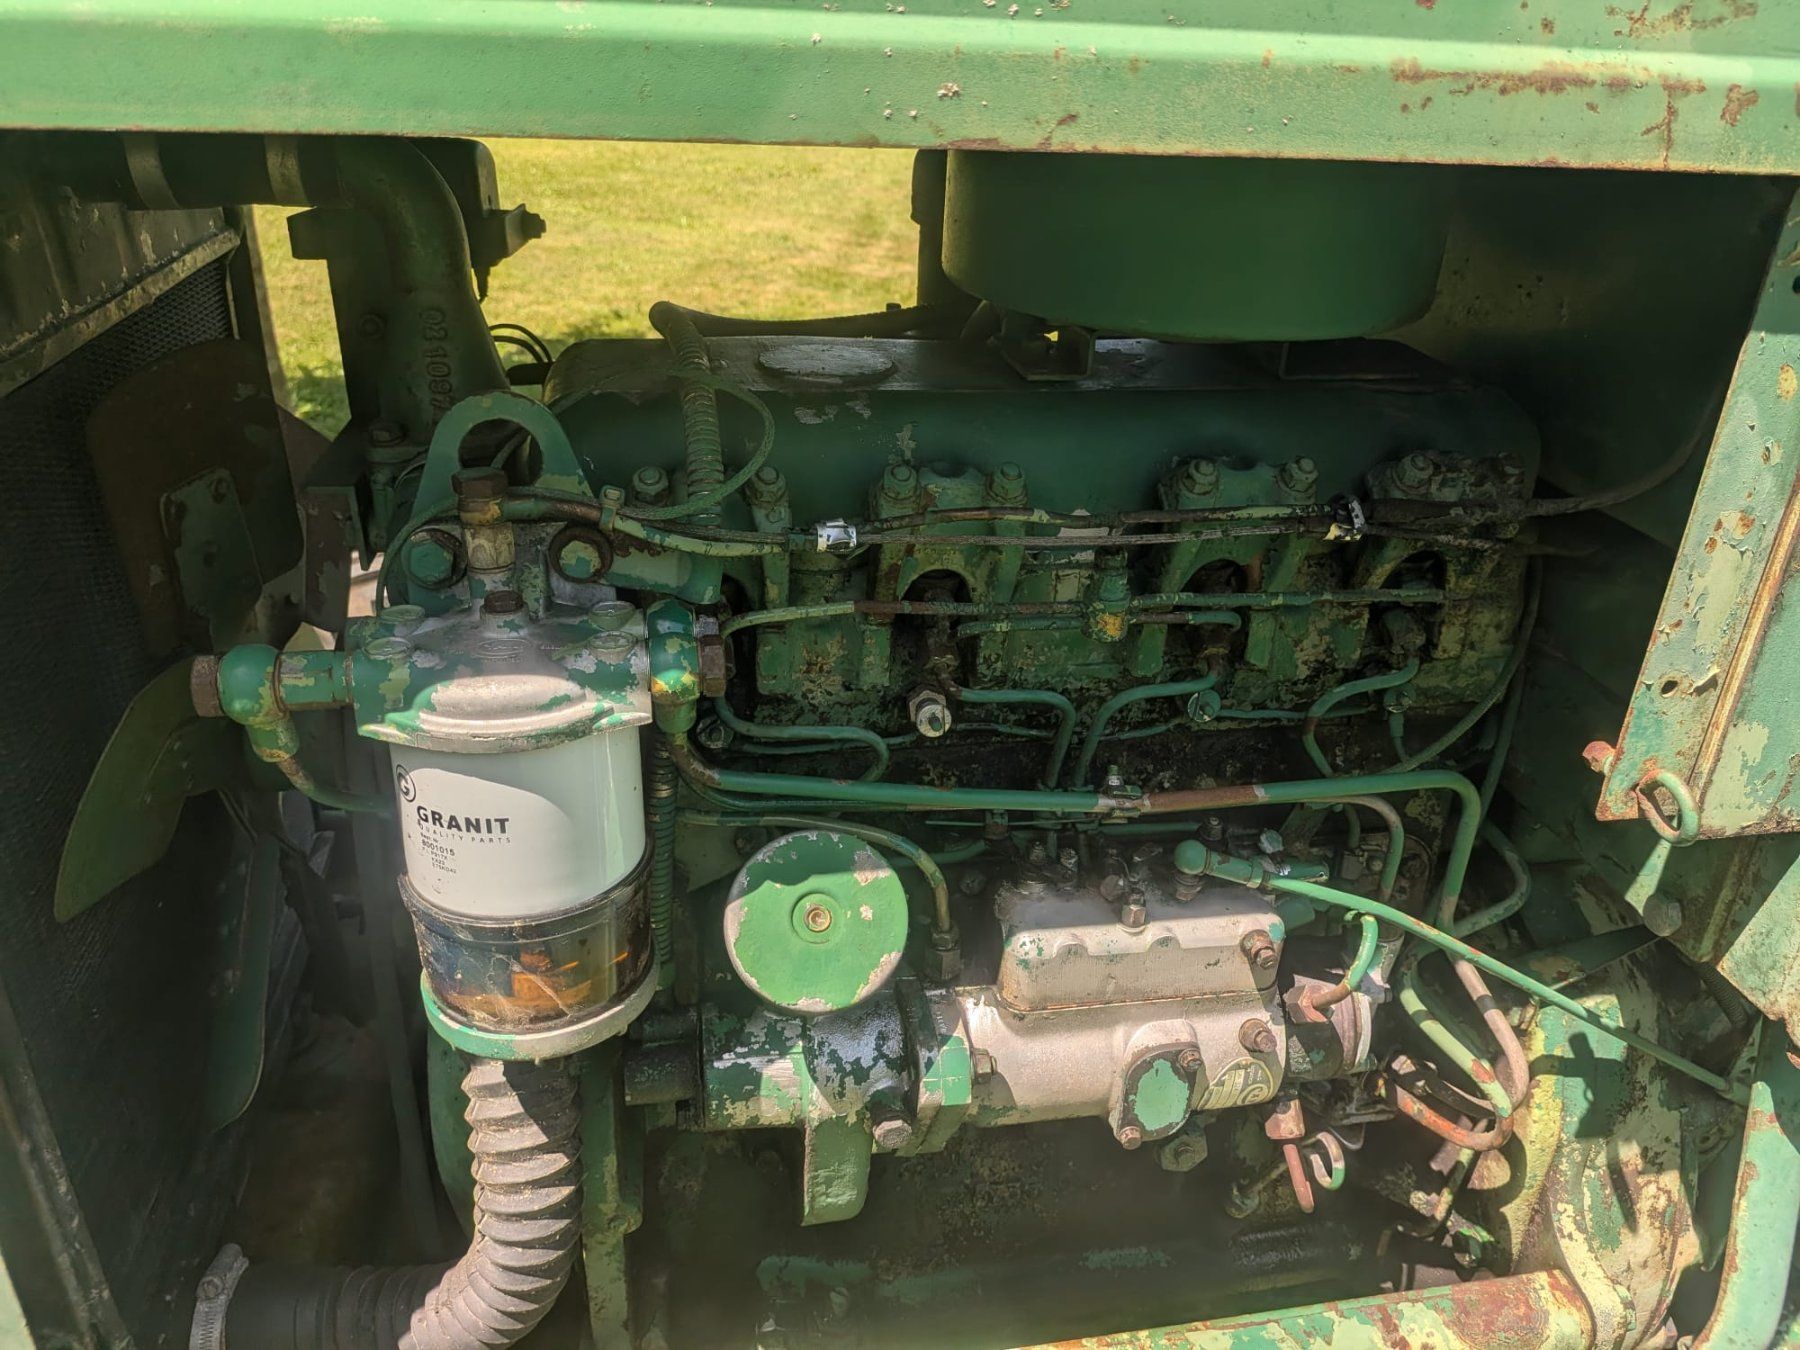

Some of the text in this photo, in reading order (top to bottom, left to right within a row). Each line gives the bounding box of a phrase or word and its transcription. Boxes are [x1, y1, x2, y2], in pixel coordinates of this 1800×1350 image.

[416, 805, 510, 833] GRANIT
[419, 824, 511, 844] QUALITY PARTS
[421, 839, 456, 857] 8001015
